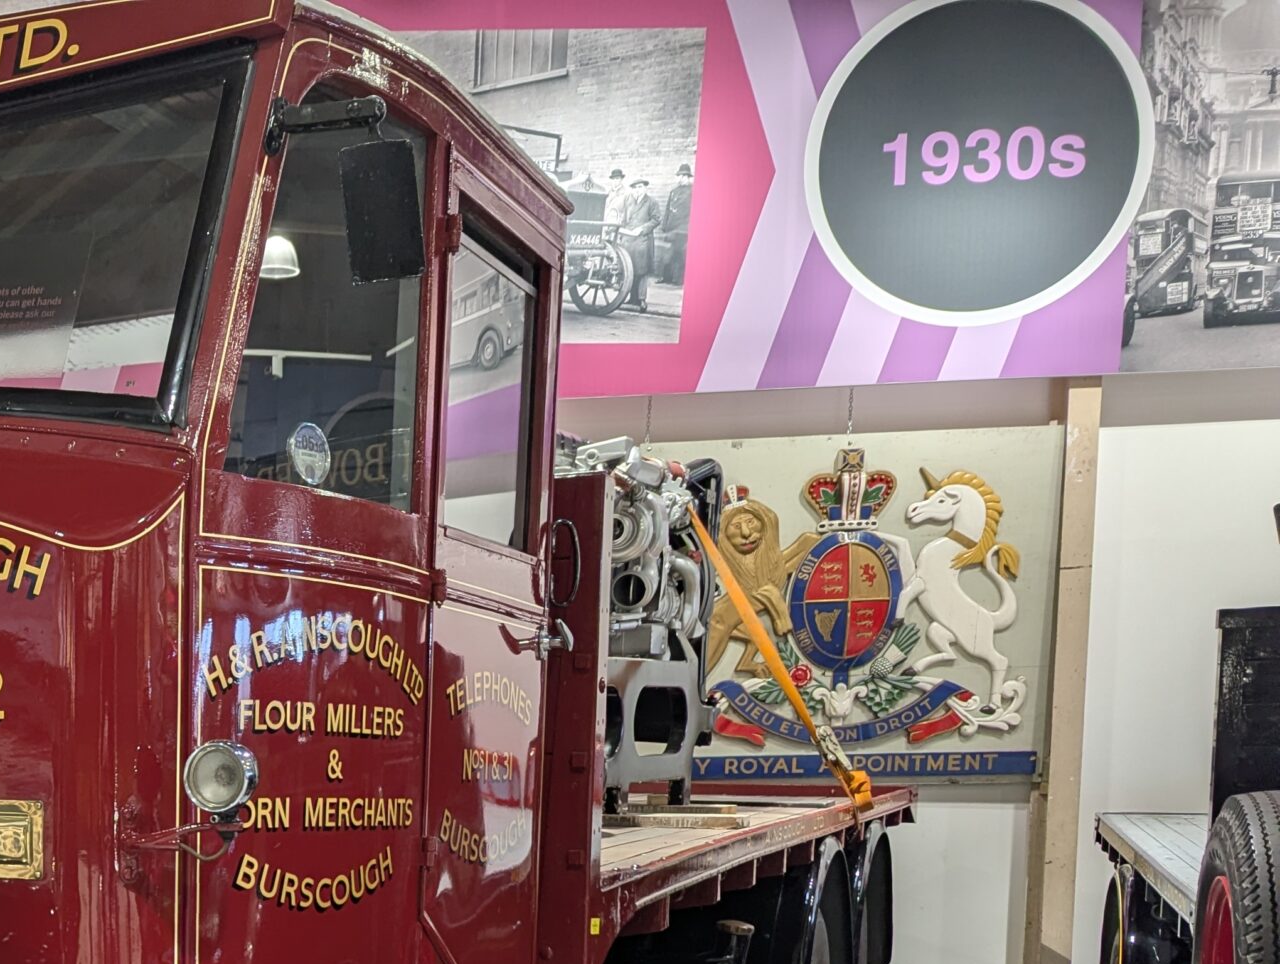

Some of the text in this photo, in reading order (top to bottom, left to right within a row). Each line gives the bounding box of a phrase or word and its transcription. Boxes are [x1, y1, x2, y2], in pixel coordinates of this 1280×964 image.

[882, 126, 1087, 186] 1930s
[5, 300, 20, 308] can
[21, 298, 35, 309] get
[36, 296, 62, 306] hands
[11, 287, 22, 296] of
[22, 285, 45, 295] other
[798, 553, 819, 581] SOIT
[446, 671, 532, 726] TELEPHONES
[239, 699, 405, 737] FLOUR MILLERS
[734, 696, 933, 742] DIEU ET ON DROIT
[327, 749, 344, 780] &
[694, 754, 999, 776] Y ROYAL APOINTMENT
[243, 797, 413, 829] ORN MERCHANTS
[440, 808, 526, 862] BURSCOUGH
[236, 846, 394, 909] BURSCOUGH
